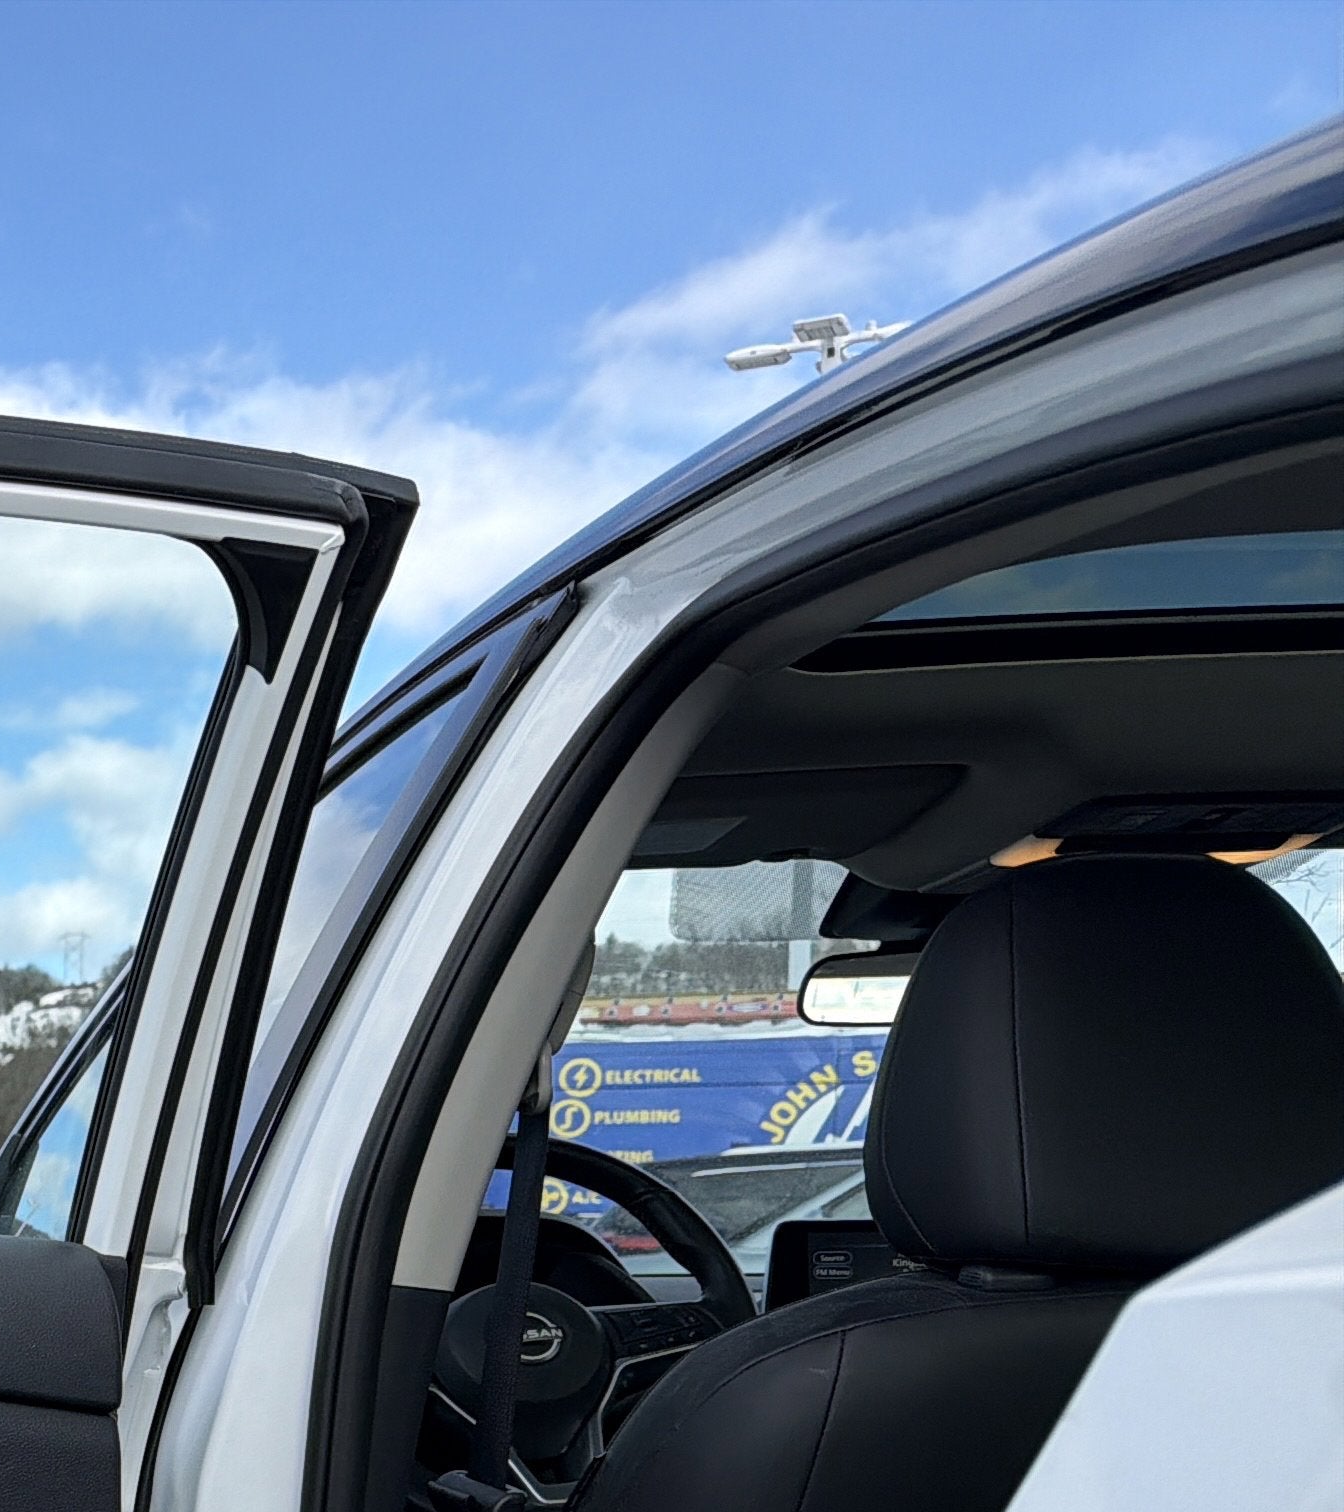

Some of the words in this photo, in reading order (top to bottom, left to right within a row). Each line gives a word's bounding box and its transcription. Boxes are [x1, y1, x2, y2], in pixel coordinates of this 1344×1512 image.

[605, 1067, 702, 1085] ELECTRICAL
[760, 1064, 839, 1144] JOHN
[594, 1108, 681, 1125] PLUMBING
[820, 1254, 846, 1262] Source
[523, 1328, 563, 1340] SAN
